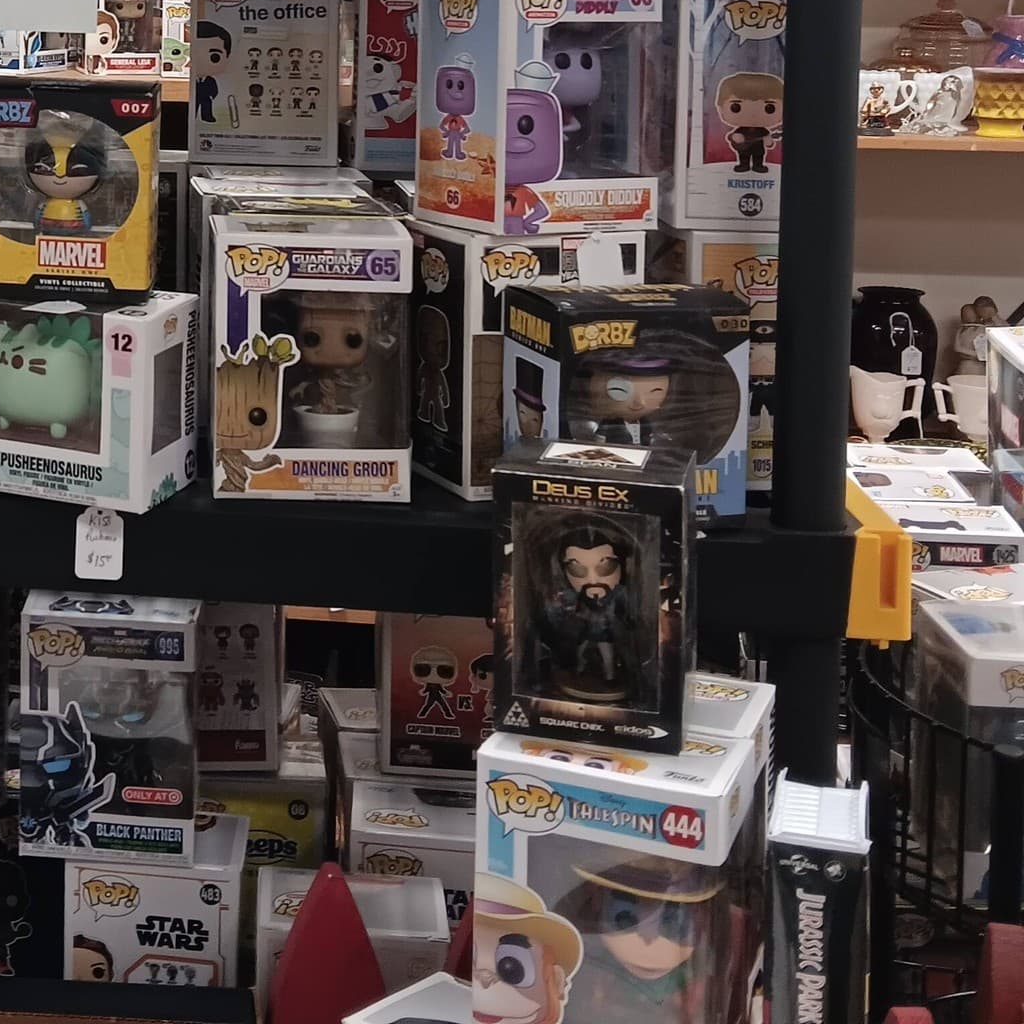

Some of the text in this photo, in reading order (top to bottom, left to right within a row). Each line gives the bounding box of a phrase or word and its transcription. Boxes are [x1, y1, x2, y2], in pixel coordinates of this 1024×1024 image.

[238, 4, 327, 21] the office
[725, 0, 787, 30] POP!
[120, 102, 151, 115] 007
[727, 179, 776, 190] KRISTOFF
[446, 189, 460, 205] 66
[554, 189, 645, 208] SQUIDDLY DIDDLY
[740, 198, 762, 213] 584
[40, 239, 105, 269] MARVEL
[225, 245, 289, 277] POP!
[291, 254, 363, 266] GUARDIANS
[306, 263, 362, 275] GALAXY
[369, 256, 397, 276] 65
[480, 251, 539, 281] POP!
[39, 278, 106, 289] VINYL COLLECTIBLE
[243, 277, 271, 289] MARVEL
[111, 333, 133, 353] 12
[570, 320, 638, 353] DORBZ
[184, 309, 197, 436] PUSHEENOSAURUS
[0, 452, 103, 482] PUSHEENOSAURUS
[292, 460, 396, 477] DANCING GROOT
[752, 459, 772, 473] 1015
[532, 478, 630, 504] DEUS EX
[939, 546, 983, 564] MARVEL
[27, 629, 85, 658] POP!
[159, 637, 180, 655] 995
[539, 716, 580, 729] SQUARE
[125, 790, 168, 802] ONLY AT
[486, 780, 564, 822] POP!
[569, 801, 657, 839] TALESPIN
[662, 811, 704, 842] 444
[95, 824, 182, 842] BLACK PANTHER
[82, 879, 140, 908] POP!
[200, 886, 222, 903] 483
[143, 915, 209, 937] STAR
[796, 888, 827, 974] JURASSIC
[136, 930, 210, 951] WARS
[798, 975, 827, 1024] PARK
